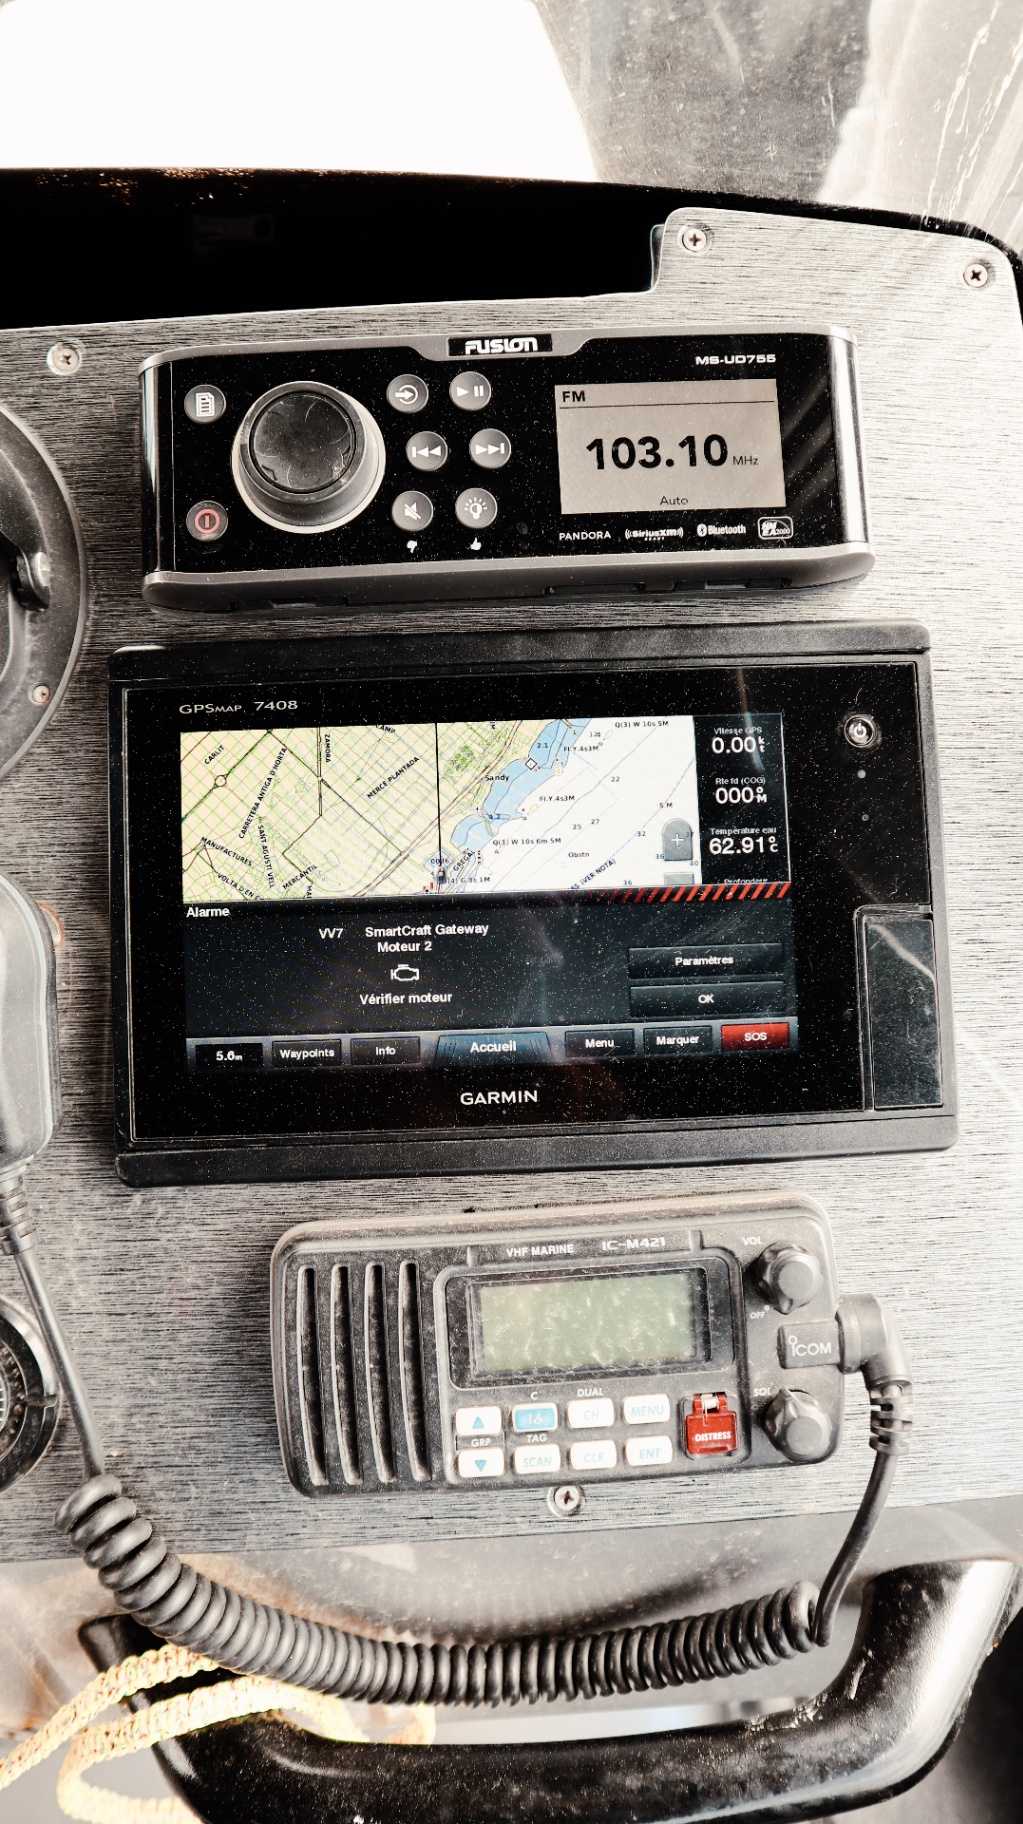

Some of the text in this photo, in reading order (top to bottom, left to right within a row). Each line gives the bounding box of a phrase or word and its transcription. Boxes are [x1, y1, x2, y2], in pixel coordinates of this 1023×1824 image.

[464, 337, 538, 355] FUSION
[694, 354, 777, 366] MS-UD755
[561, 390, 587, 403] FM
[586, 434, 759, 470] 103.10 MHz
[659, 494, 689, 506] Auto
[558, 530, 612, 541] PANDORA
[707, 524, 747, 535] Bluetooth
[254, 700, 299, 712] 7408
[713, 726, 763, 735] Vitesse GPS
[324, 733, 332, 763] ZAMORA
[711, 737, 756, 754] 0.00
[204, 744, 225, 765] CARLIT
[387, 756, 420, 782] PLANTADA
[484, 774, 510, 782] Sandy
[741, 776, 766, 786] (COG)
[715, 787, 754, 804] 000
[238, 802, 261, 839] CARRETERA
[257, 776, 273, 801] ANTIGA
[200, 836, 253, 867] MANUFACTURES
[709, 837, 765, 855] 62.91
[257, 825, 276, 889] SANT AGUSTI VELL
[217, 872, 239, 889] VOLTA
[283, 864, 318, 890] MERCANTIL
[186, 906, 230, 919] Alarme
[365, 924, 490, 938] SmartCraft Gateway
[377, 941, 433, 953] Moteur 2
[674, 954, 734, 967] Paramètres
[359, 991, 453, 1006] Vérifier moteur
[698, 994, 715, 1005] OK
[585, 1037, 615, 1049] Menu
[656, 1033, 700, 1047] Marquer
[744, 1031, 768, 1042] SOS
[279, 1047, 335, 1061] Waypoints
[375, 1044, 397, 1056] Info
[469, 1040, 517, 1054] Accueil
[460, 1090, 539, 1106] GARMIN
[601, 1237, 667, 1251] IC-M421
[741, 1237, 764, 1246] VOL
[506, 1243, 575, 1258] VHF MARINE
[749, 1310, 766, 1320] OFF
[530, 1391, 539, 1401] C
[576, 1387, 604, 1398] DUAL
[753, 1387, 773, 1398] SQL
[582, 1408, 601, 1423] CH
[630, 1403, 665, 1419] MENU
[527, 1413, 544, 1427] 16
[470, 1437, 492, 1448] GRP
[526, 1433, 548, 1444] TAG
[694, 1430, 732, 1443] DISTRESS
[522, 1453, 553, 1468] SCAN
[582, 1450, 605, 1466] CLR
[638, 1446, 662, 1462] ENT
